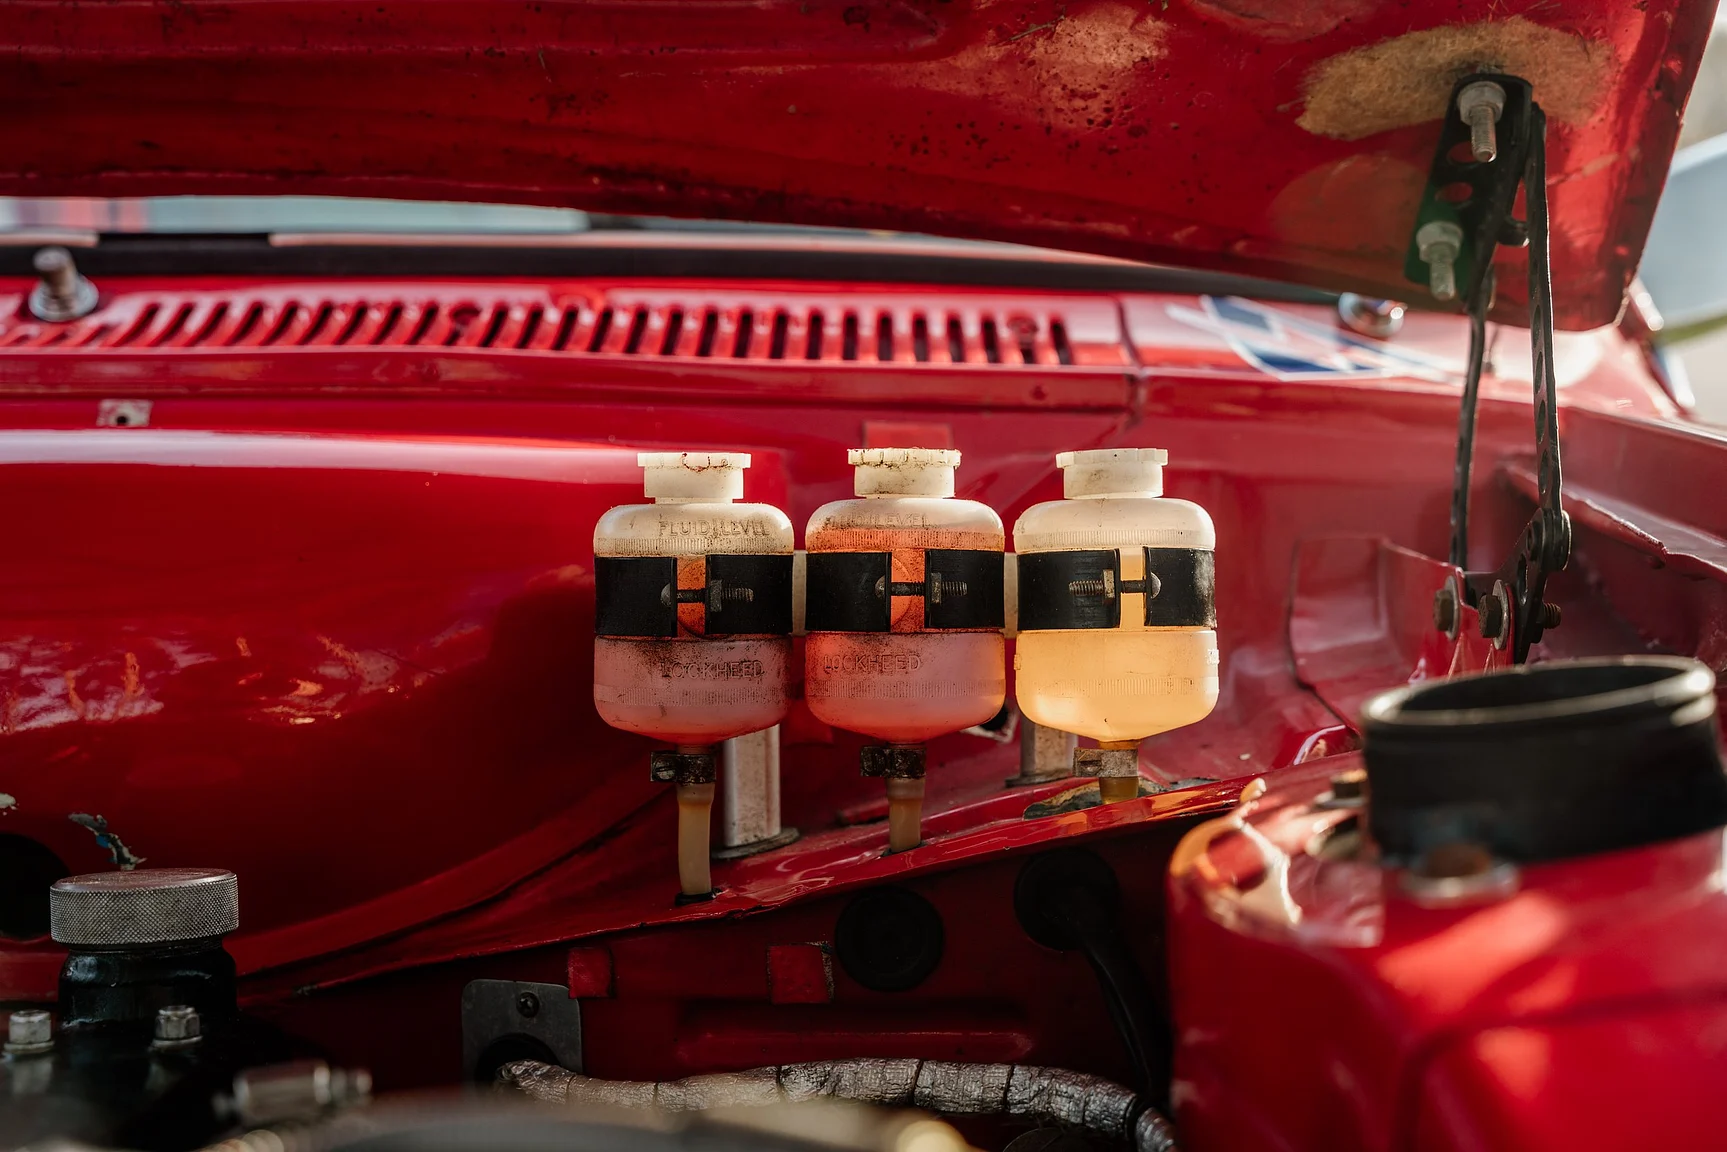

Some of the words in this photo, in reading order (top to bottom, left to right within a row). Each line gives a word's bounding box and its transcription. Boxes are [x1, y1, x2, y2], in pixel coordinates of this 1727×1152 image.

[659, 519, 711, 537] FLUID
[719, 518, 770, 537] LEVEL
[874, 512, 931, 528] LEVEL
[661, 660, 764, 679] LOCKHEED
[824, 654, 921, 672] LOCKHEED
